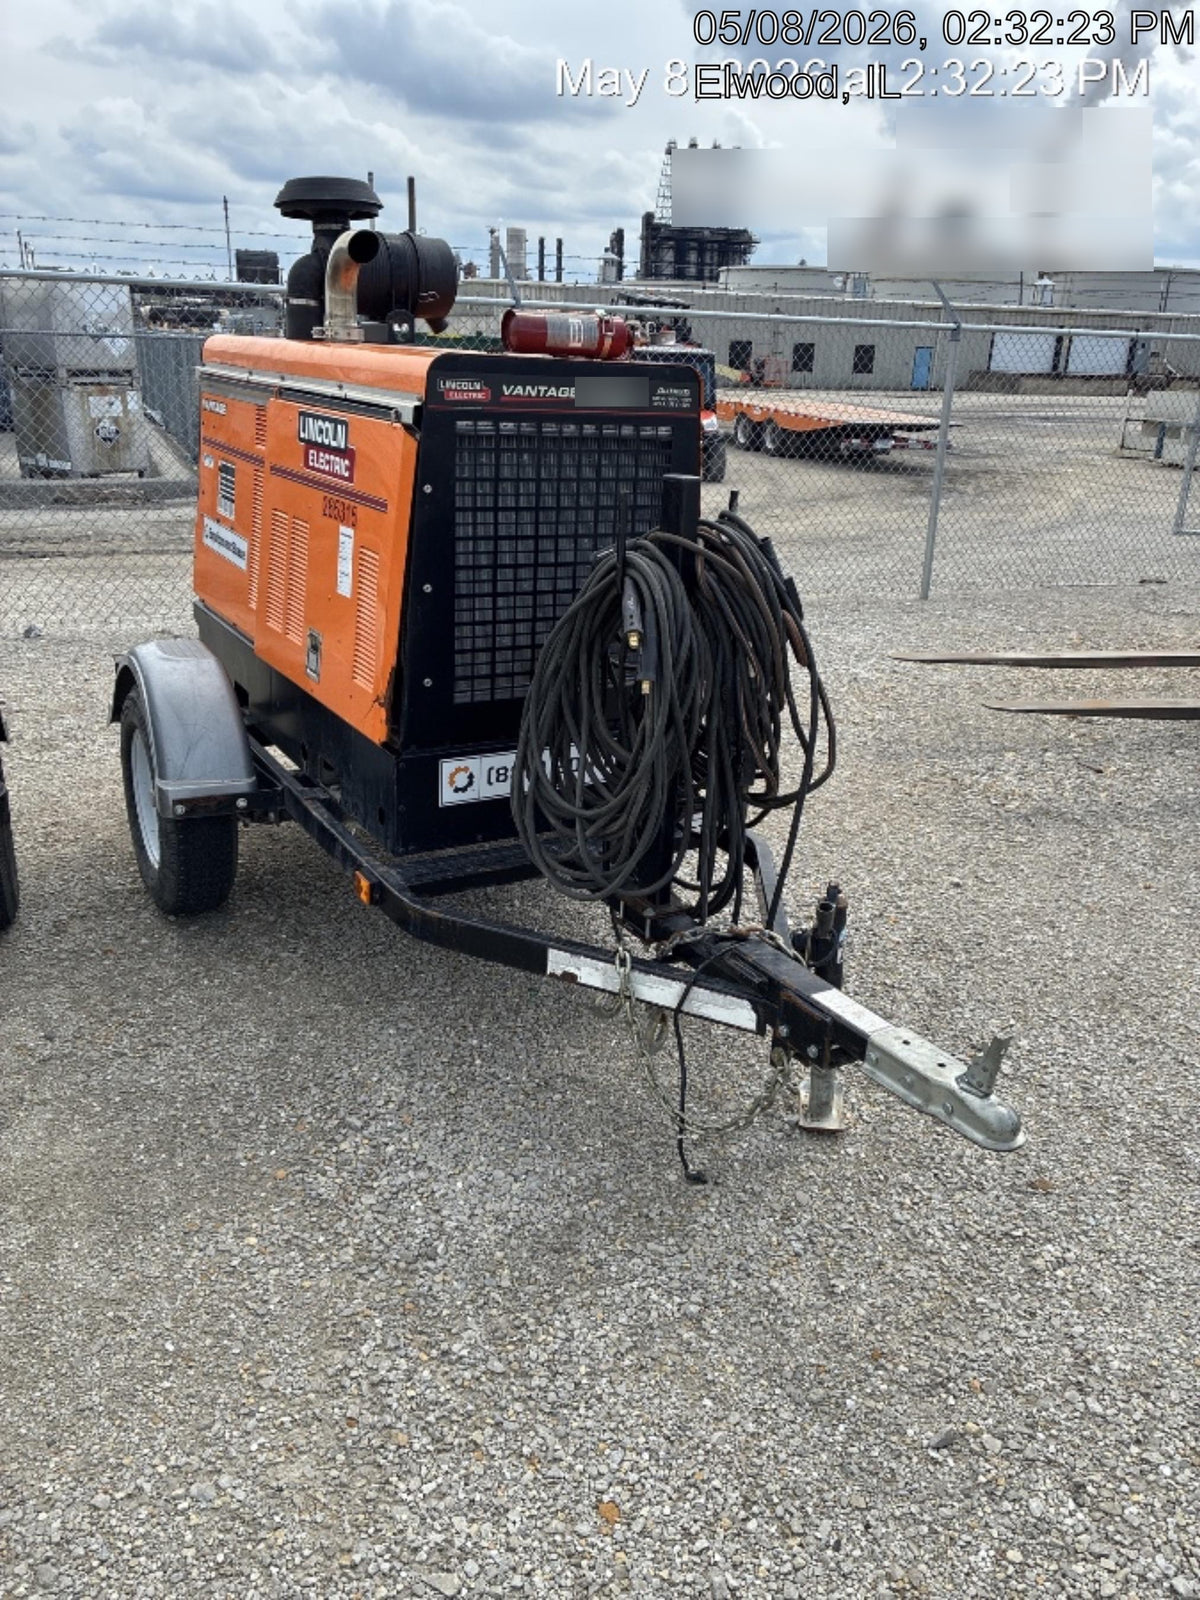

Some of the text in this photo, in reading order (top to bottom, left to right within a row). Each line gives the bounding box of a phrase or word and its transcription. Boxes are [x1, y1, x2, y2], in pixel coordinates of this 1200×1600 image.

[440, 379, 481, 390] LINCOLN
[502, 384, 576, 398] VANTAGE
[300, 415, 346, 448] LINCOLN
[308, 449, 351, 477] ELECTRIC
